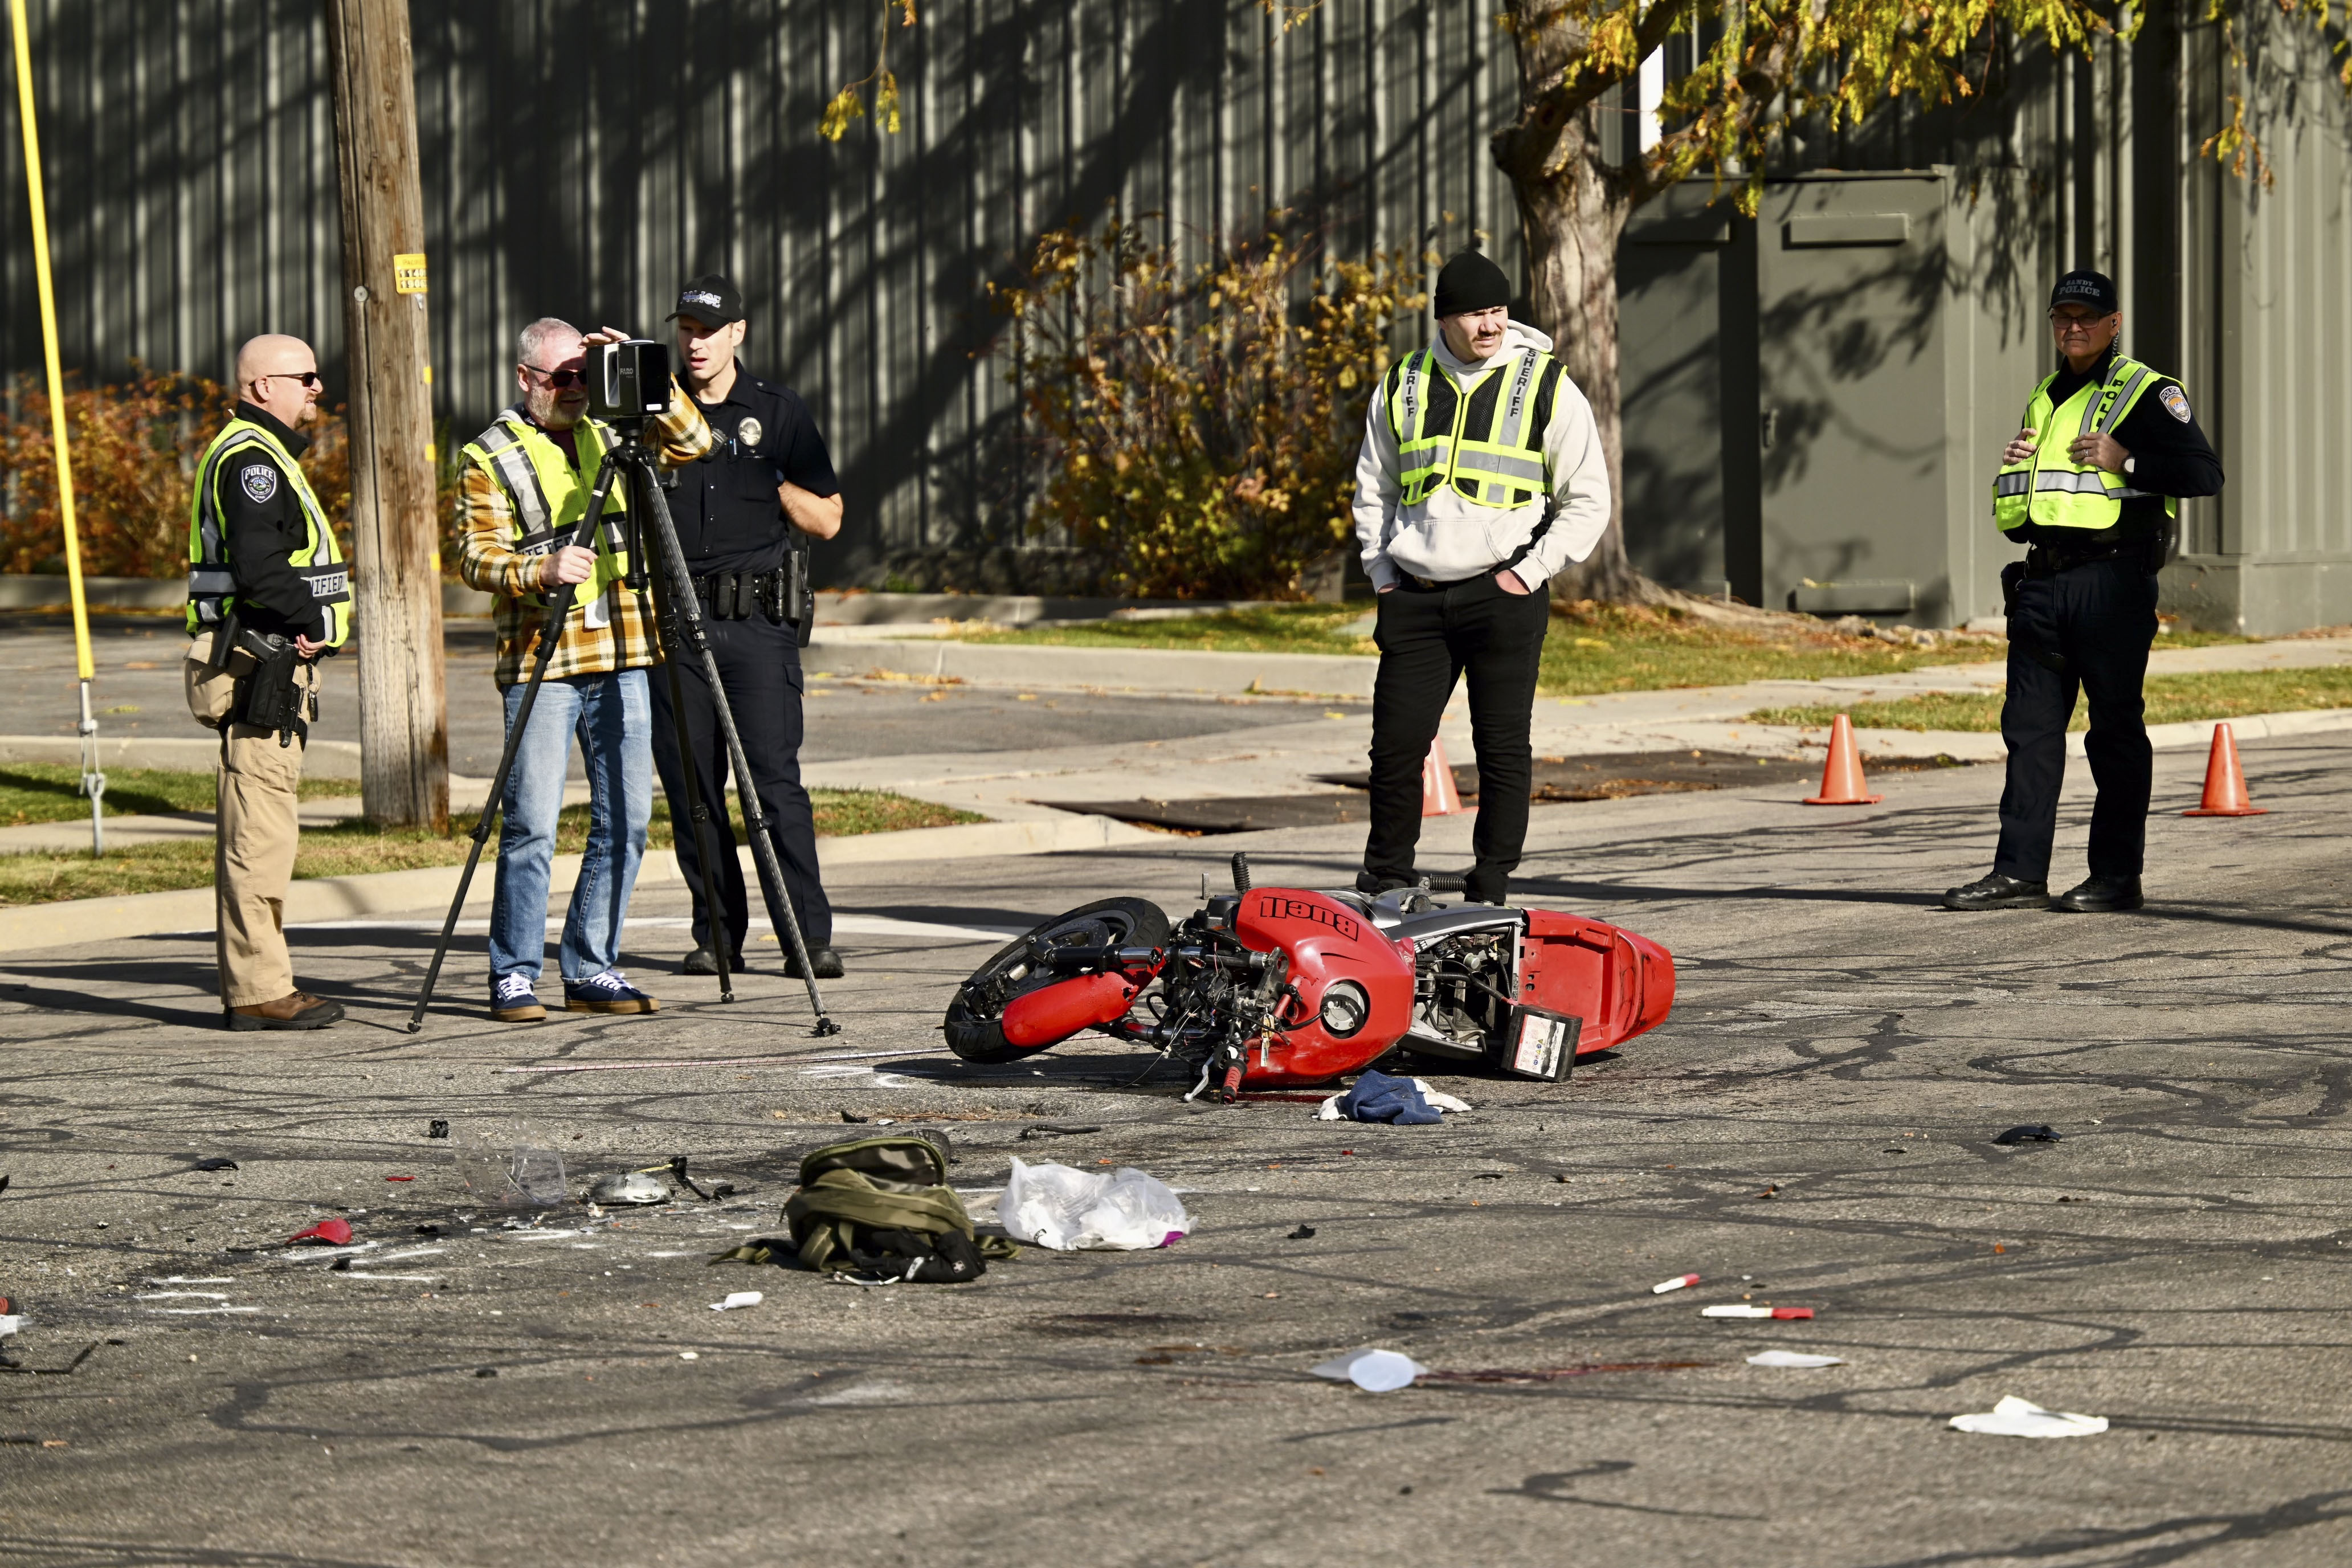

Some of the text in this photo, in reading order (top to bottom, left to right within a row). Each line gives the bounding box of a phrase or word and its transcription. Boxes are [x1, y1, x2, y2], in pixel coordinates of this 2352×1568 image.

[2059, 285, 2100, 296] POLICE
[1406, 352, 1424, 418] SHERIFF
[1509, 348, 1537, 417] SHERIFF
[245, 467, 273, 482] POLICE
[1260, 896, 1359, 942] Buell
